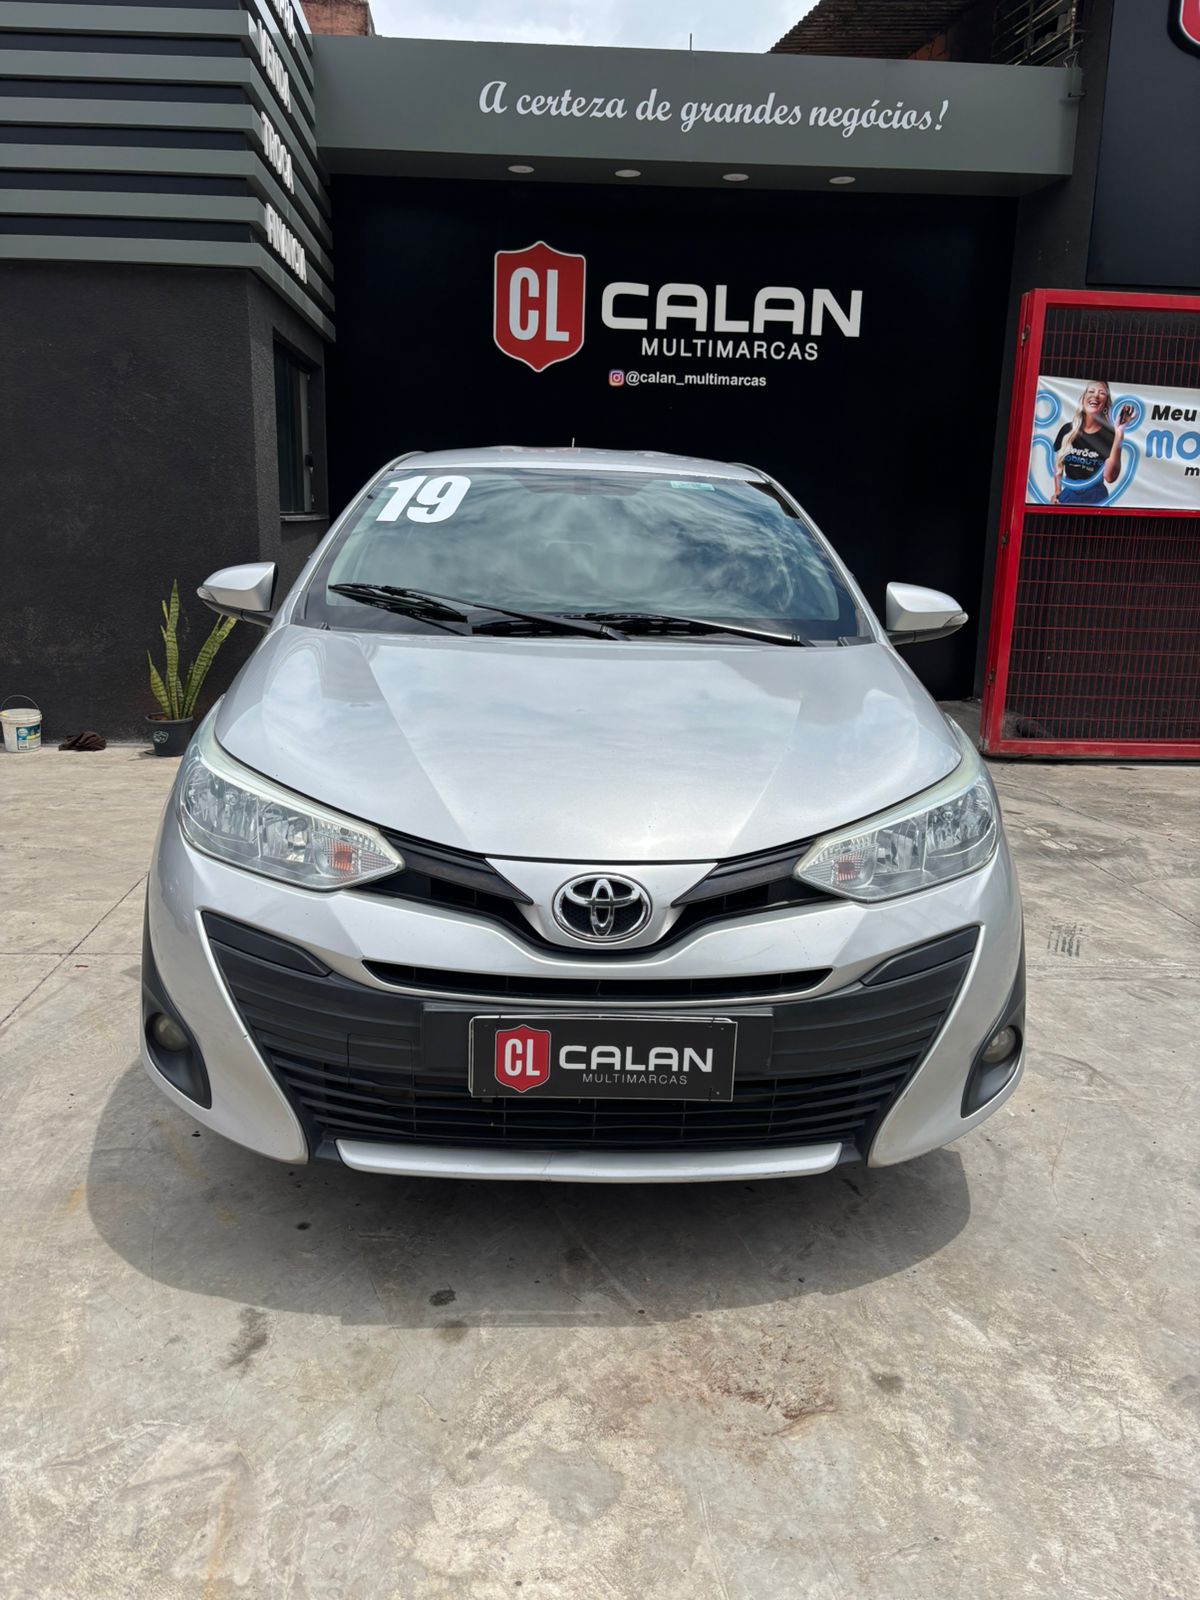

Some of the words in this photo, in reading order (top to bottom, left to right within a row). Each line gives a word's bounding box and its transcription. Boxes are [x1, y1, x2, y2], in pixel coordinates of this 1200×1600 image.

[257, 18, 292, 114] VENDA
[479, 80, 508, 114] A
[516, 89, 628, 119] certeza
[635, 88, 673, 122] de
[680, 92, 802, 133] grandes
[808, 99, 949, 138] negócios!
[261, 111, 295, 195] TROCA
[265, 203, 308, 284] FINANCIA
[509, 267, 570, 342] CL
[601, 281, 863, 338] CALAN
[641, 337, 819, 361] MULTIMARCAS
[625, 370, 767, 387] @calan_multimarcas
[1151, 404, 1198, 422] Meu
[375, 475, 472, 523] 19
[504, 1038, 541, 1077] CL
[558, 1045, 714, 1073] CALAN
[582, 1073, 688, 1085] MULTIMARCAS
